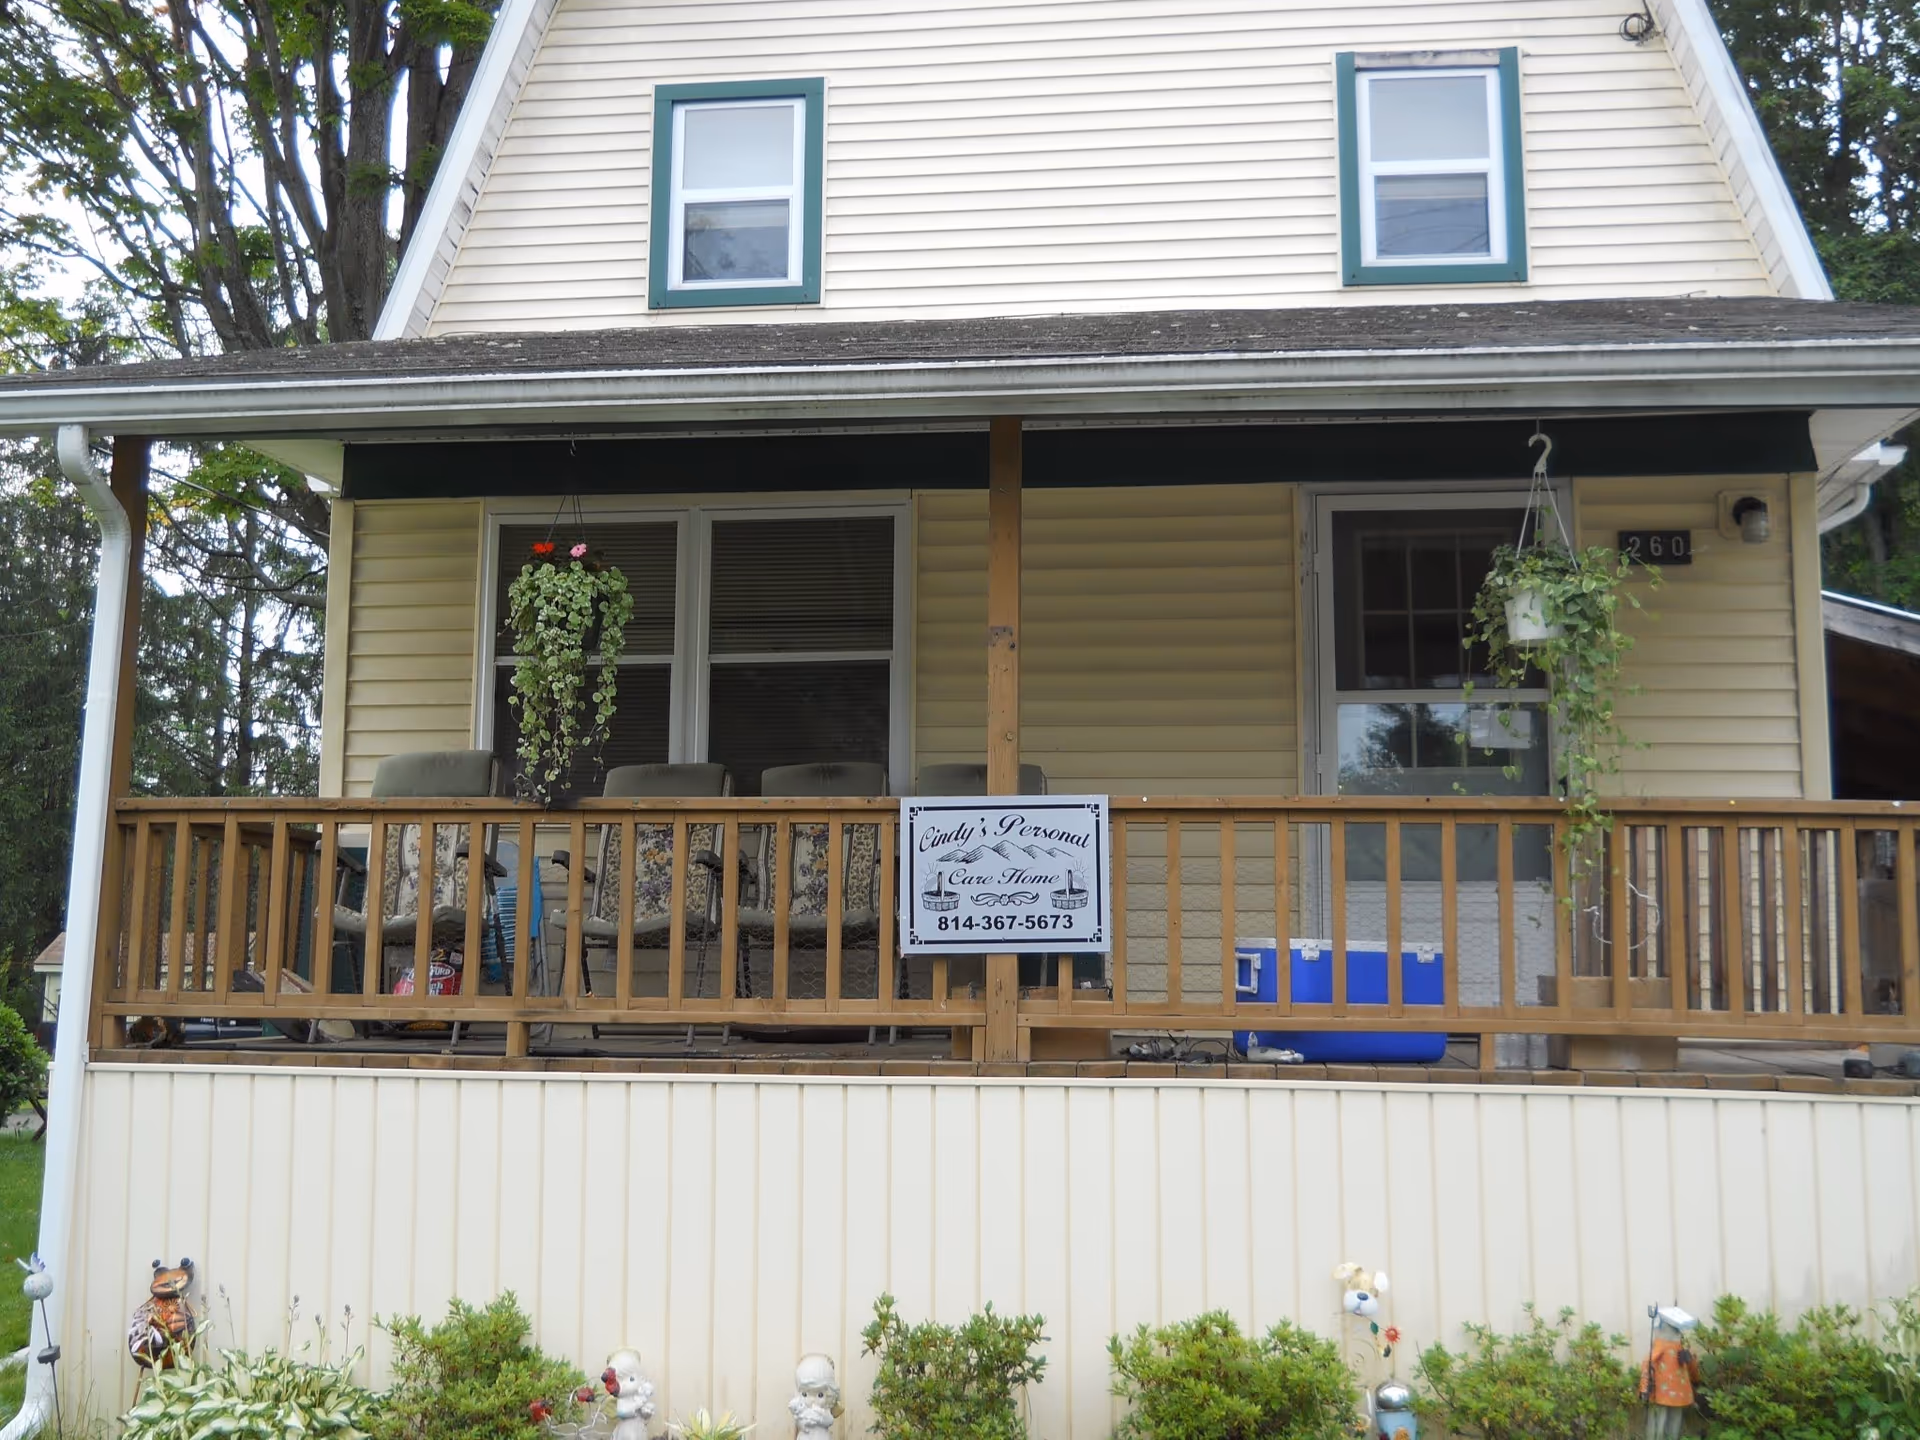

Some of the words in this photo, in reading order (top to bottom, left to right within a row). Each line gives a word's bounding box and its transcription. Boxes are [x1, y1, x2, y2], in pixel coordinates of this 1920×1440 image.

[1628, 536, 1684, 556] 260
[919, 818, 987, 853] Cindy's
[994, 813, 1090, 848] Personal
[948, 868, 994, 885] Care
[997, 867, 1060, 885] Home
[937, 914, 1074, 931] 814-367-5673
